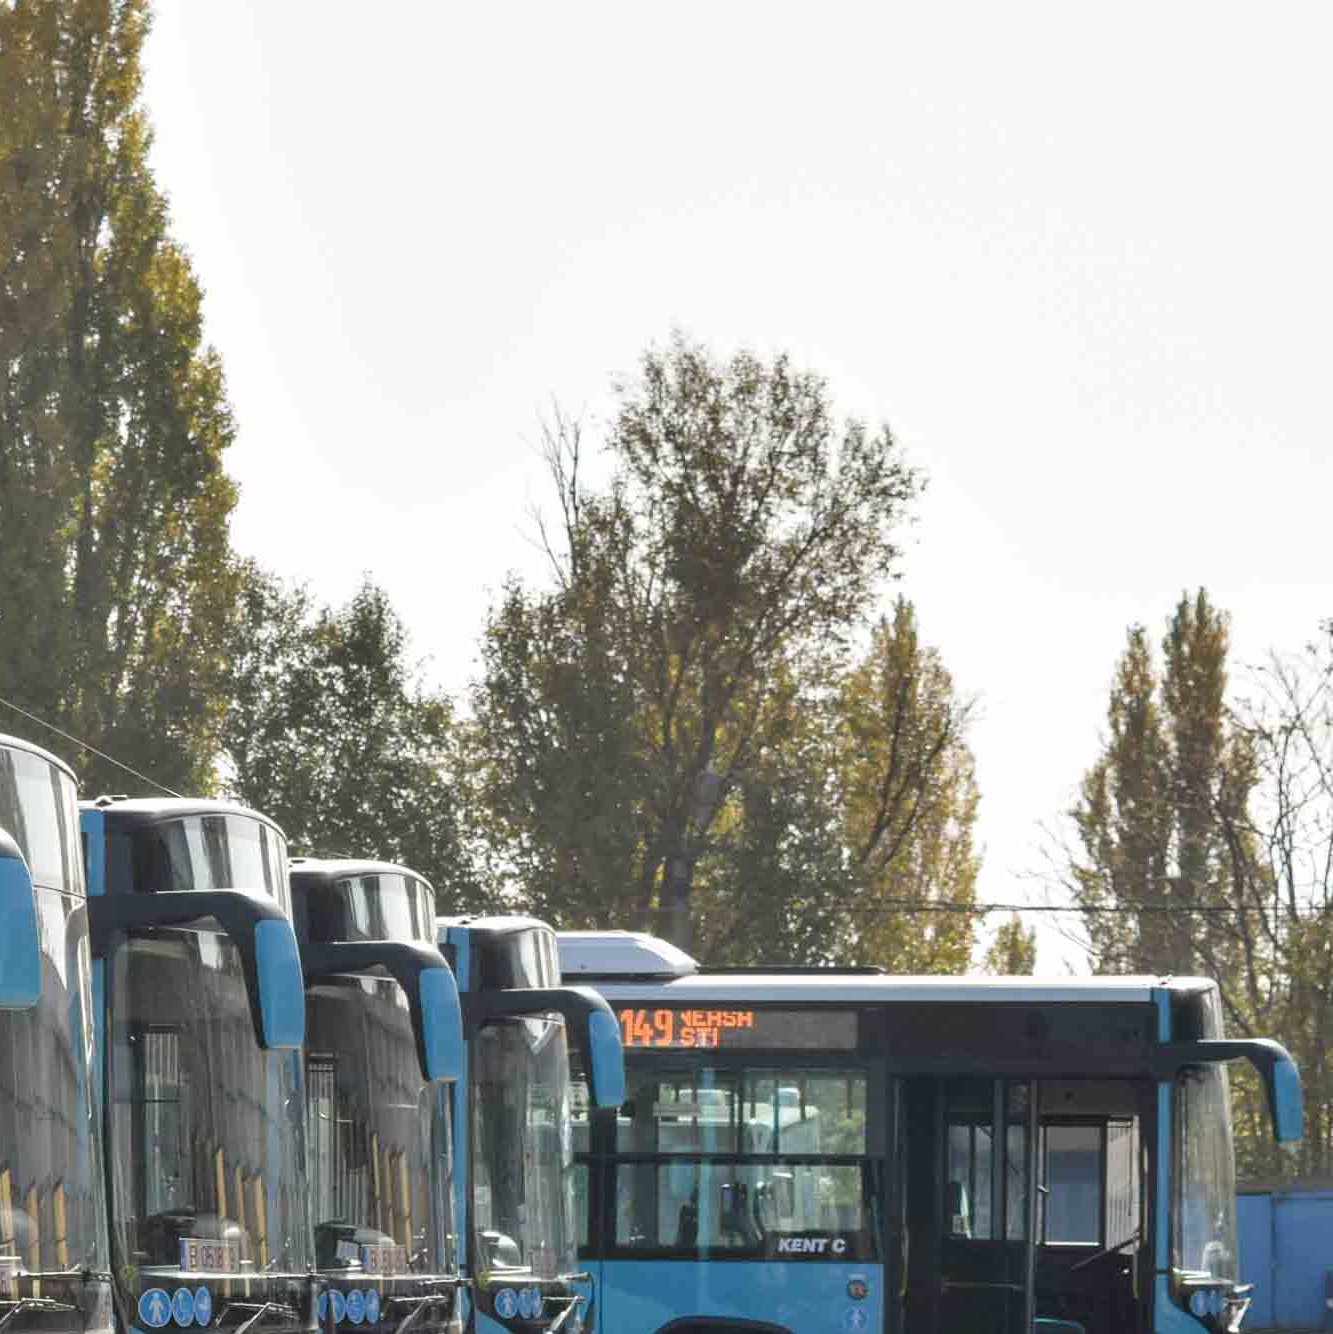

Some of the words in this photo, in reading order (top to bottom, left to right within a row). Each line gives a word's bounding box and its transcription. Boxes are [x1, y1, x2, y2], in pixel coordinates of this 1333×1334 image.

[620, 1009, 674, 1047] 149
[778, 1238, 828, 1253] KENT
[832, 1238, 846, 1254] C
